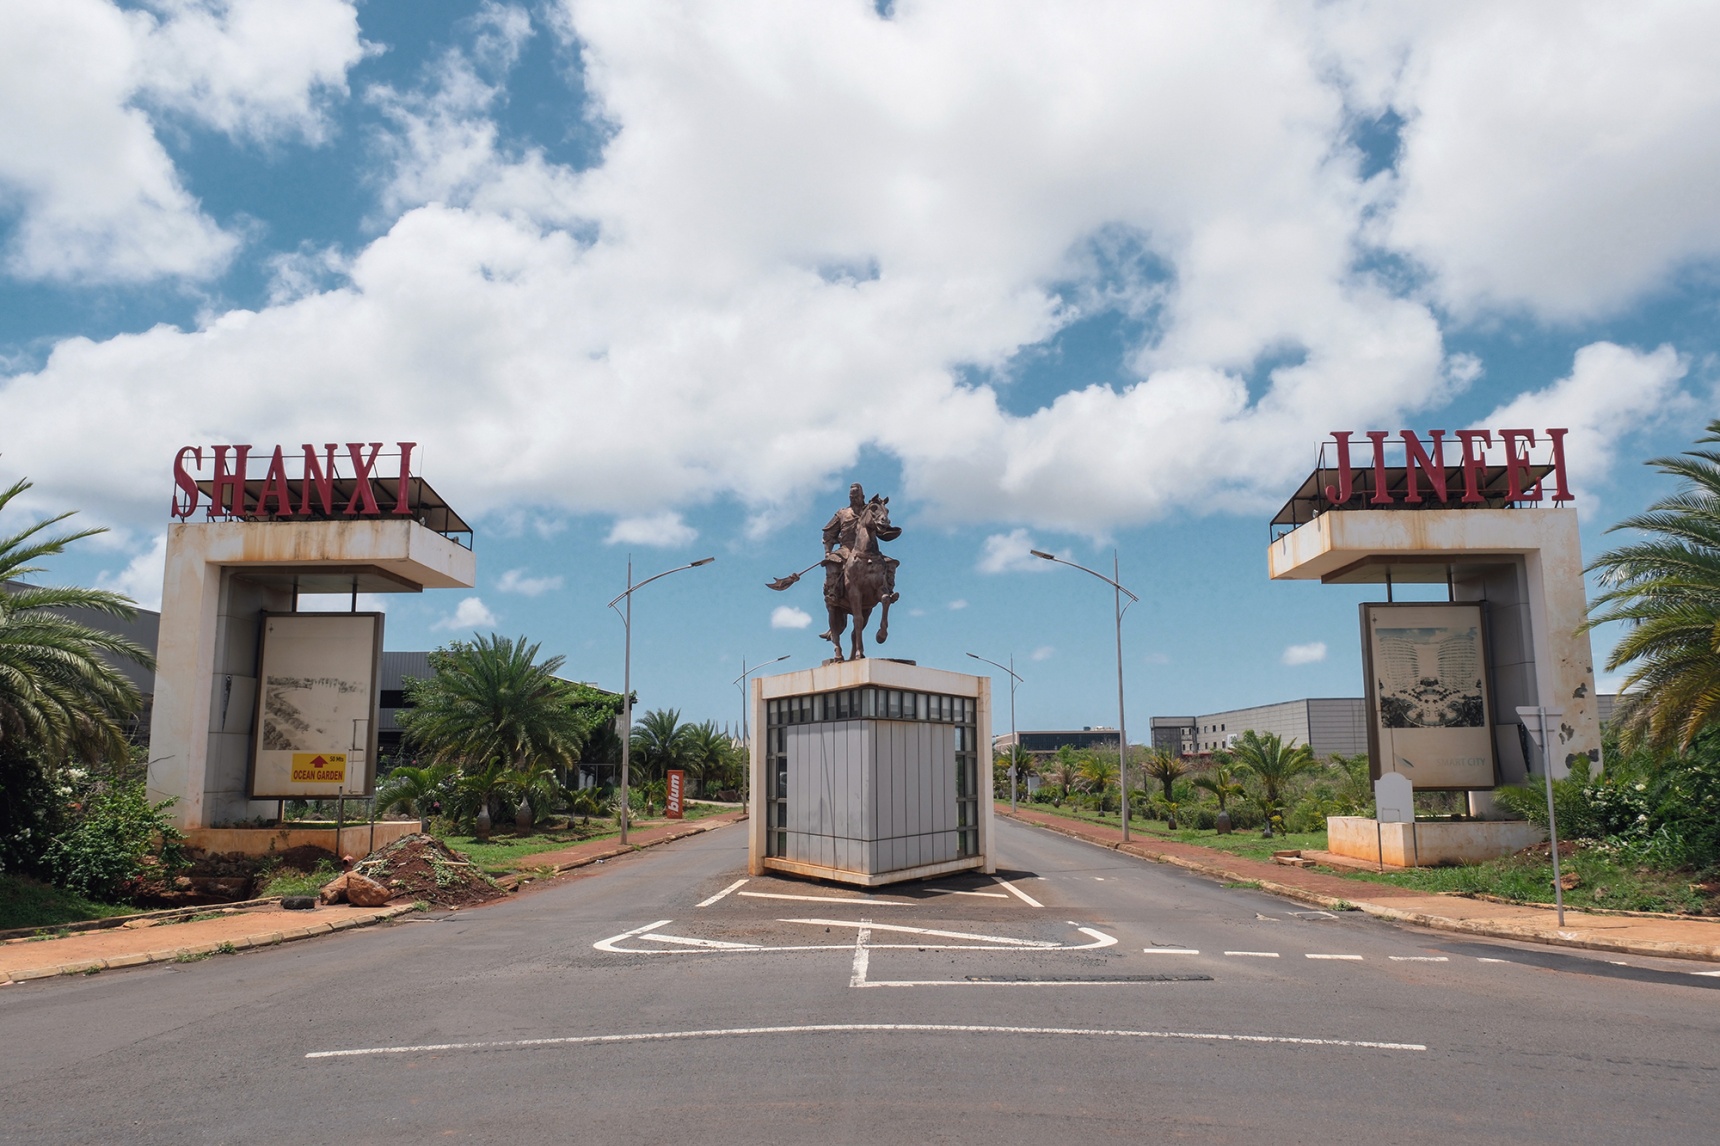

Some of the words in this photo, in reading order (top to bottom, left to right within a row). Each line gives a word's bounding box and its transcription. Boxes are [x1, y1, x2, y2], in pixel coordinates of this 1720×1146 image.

[171, 441, 417, 518] SHANXI
[1325, 427, 1575, 505] JINFEI
[294, 770, 316, 780] OCEAN
[316, 770, 343, 780] GARDEN
[1436, 758, 1465, 767] SMART
[1467, 758, 1486, 767] CITY
[668, 774, 680, 812] blum
